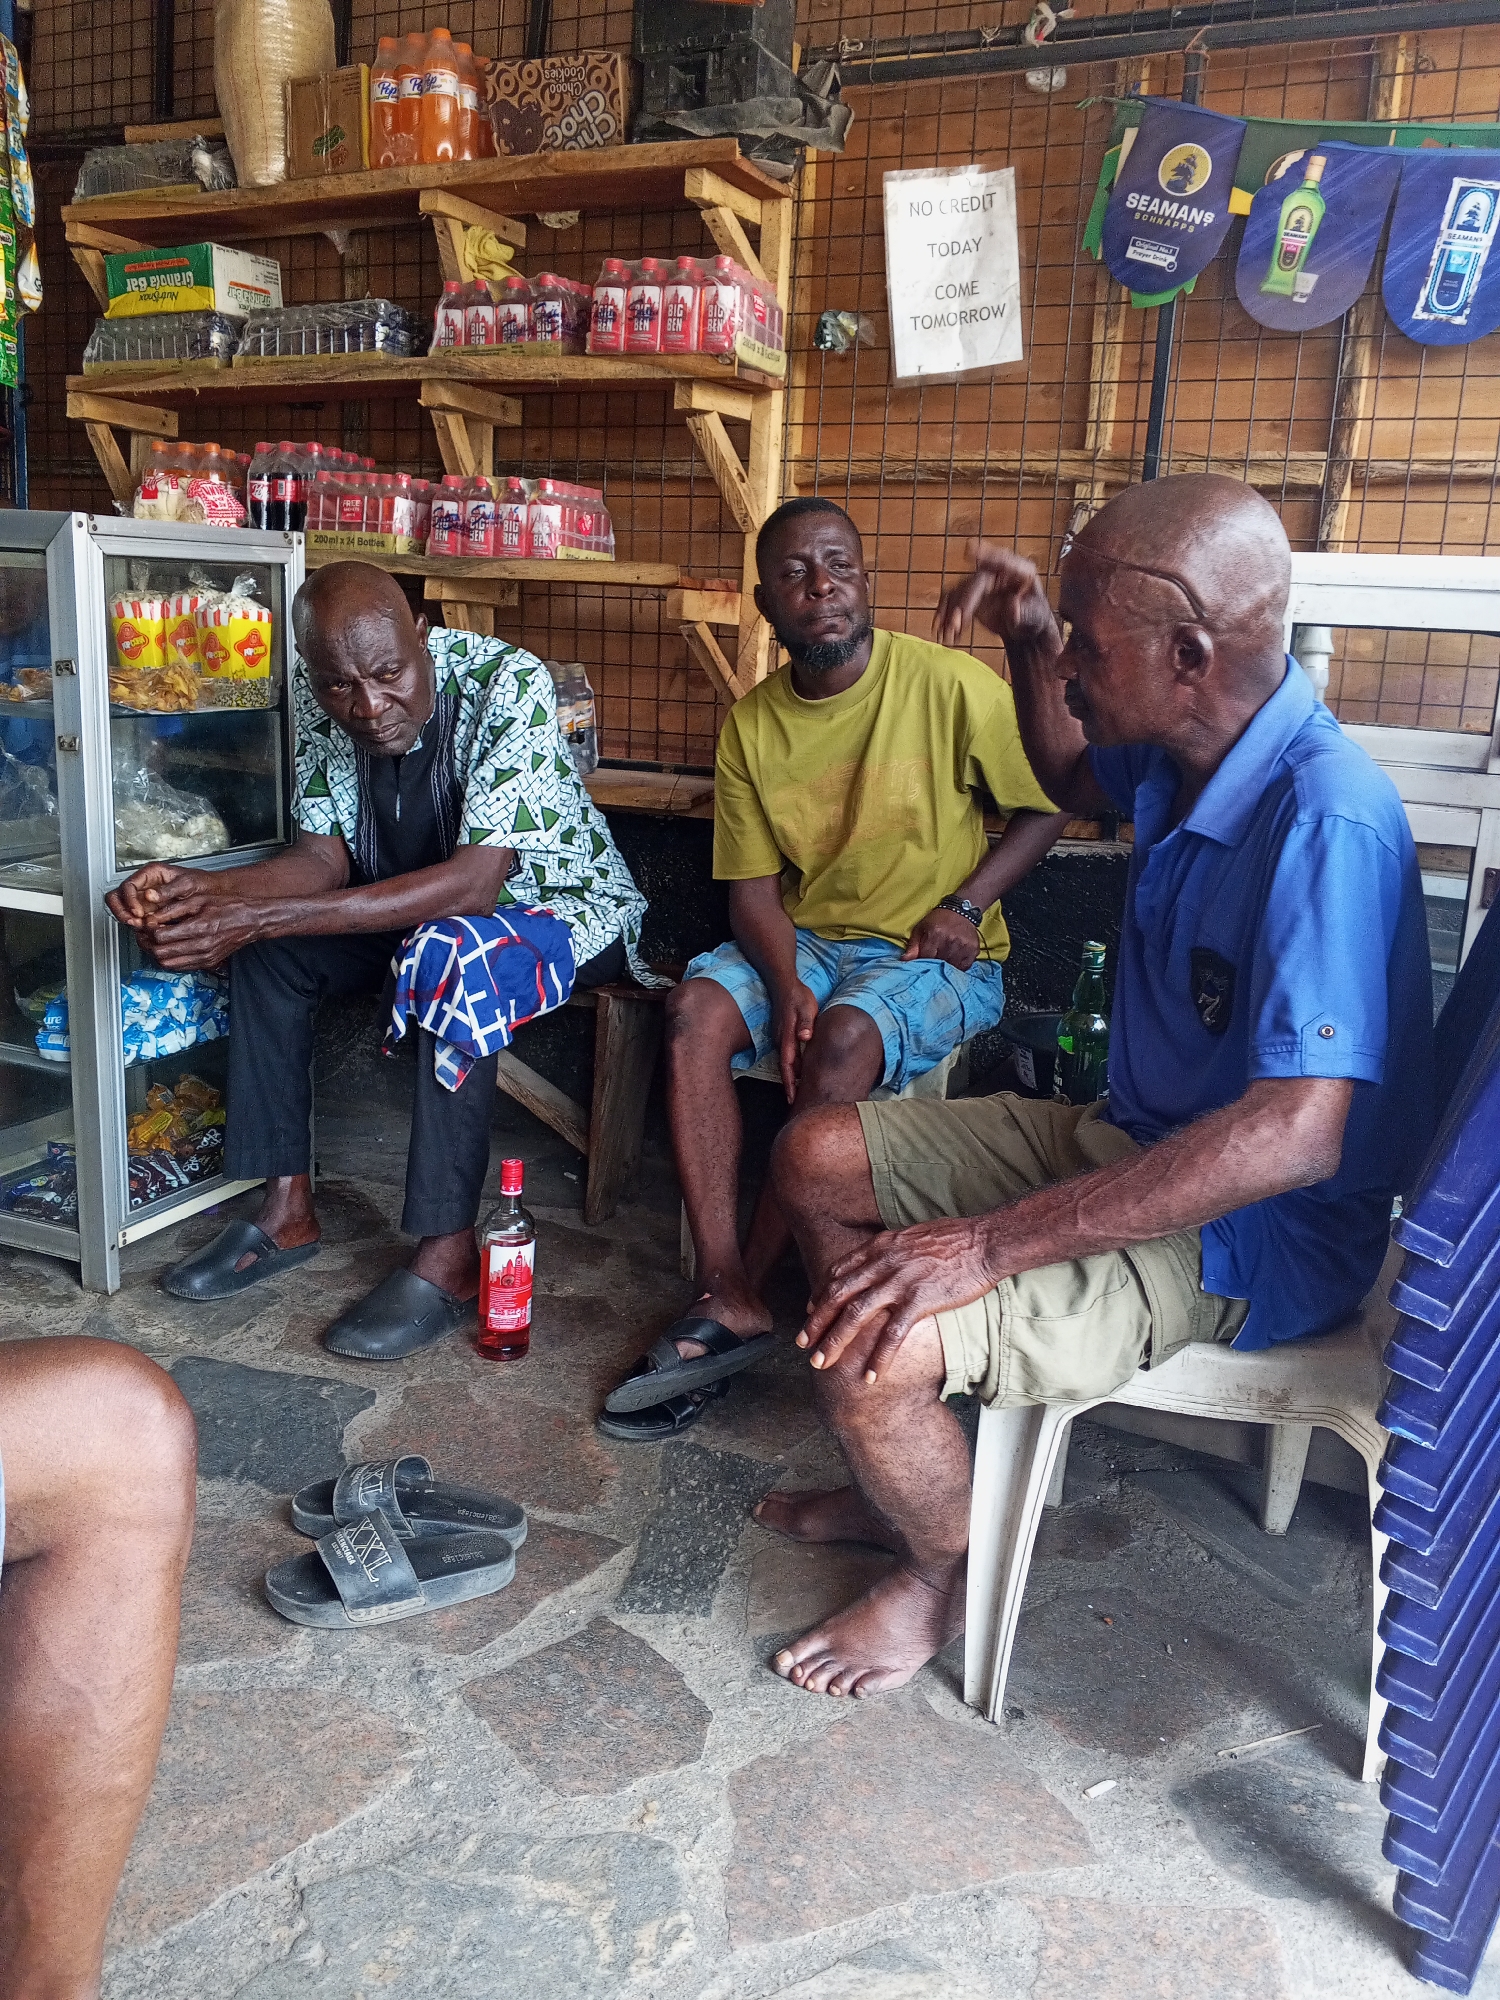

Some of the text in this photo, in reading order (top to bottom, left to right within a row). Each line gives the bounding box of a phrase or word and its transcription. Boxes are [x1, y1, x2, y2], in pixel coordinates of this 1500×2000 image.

[544, 66, 585, 82] Cookies
[378, 81, 398, 98] Pop
[549, 81, 582, 96] Choco
[545, 90, 606, 149] Choc
[909, 192, 997, 217] NO CREDIT
[1134, 212, 1195, 233] SCHNAPPS
[927, 236, 983, 258] TODAY
[126, 270, 195, 293] Granola Bar
[935, 280, 980, 300] COME
[667, 303, 684, 318] BIG
[708, 304, 724, 318] BIG
[909, 303, 1007, 331] TOMORROW
[471, 322, 486, 335] BIG
[597, 318, 613, 332] BEN
[634, 318, 650, 332] BEN
[666, 317, 683, 332] BEN
[707, 318, 723, 332] BEN
[342, 499, 361, 507] FREE
[503, 519, 519, 532] BIG
[314, 534, 339, 544] 200ml
[346, 536, 355, 547] 24
[357, 537, 385, 548] Bottles
[434, 529, 448, 542] BEN
[502, 532, 519, 546] BEN
[346, 1517, 393, 1583] XXL
